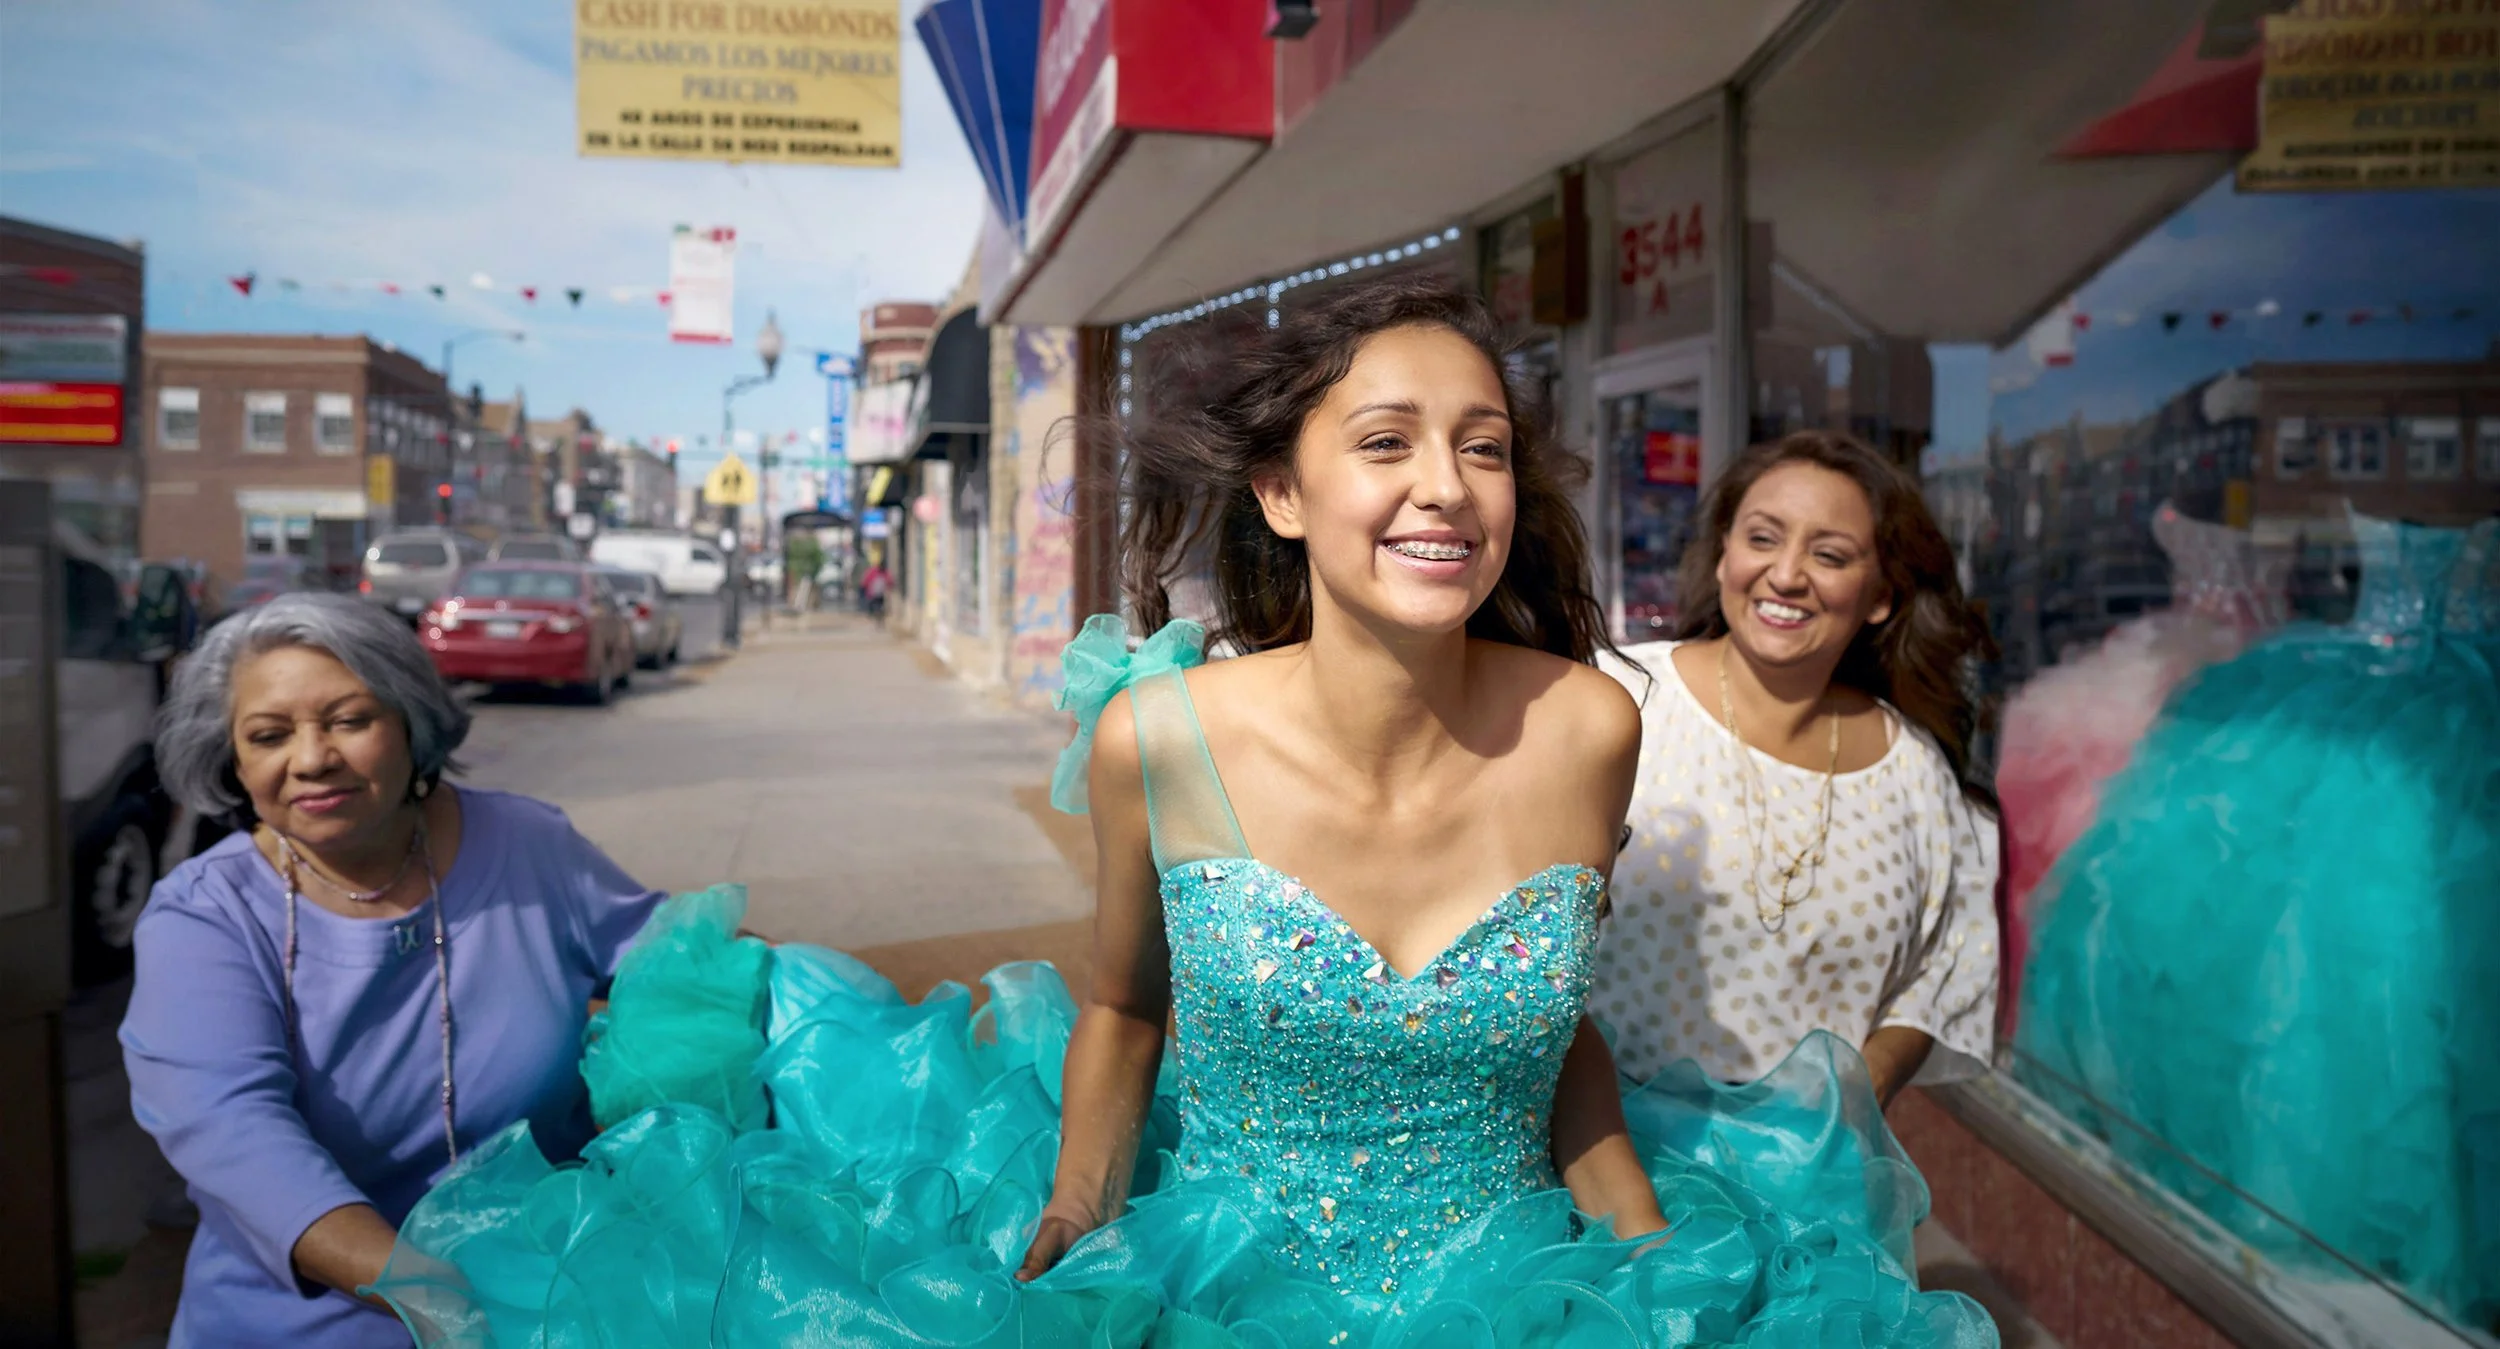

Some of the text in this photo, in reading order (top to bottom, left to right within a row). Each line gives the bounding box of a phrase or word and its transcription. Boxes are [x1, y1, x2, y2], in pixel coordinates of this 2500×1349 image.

[667, 1, 728, 31] FOR
[735, 3, 897, 39] DIAMONDS
[580, 37, 896, 79] PAGAMOS LOS MEJORES
[682, 75, 800, 105] PRECIOS
[741, 113, 860, 133] EXPERIENCIA
[1620, 203, 1706, 286] 3544
[1646, 277, 1670, 316] A
